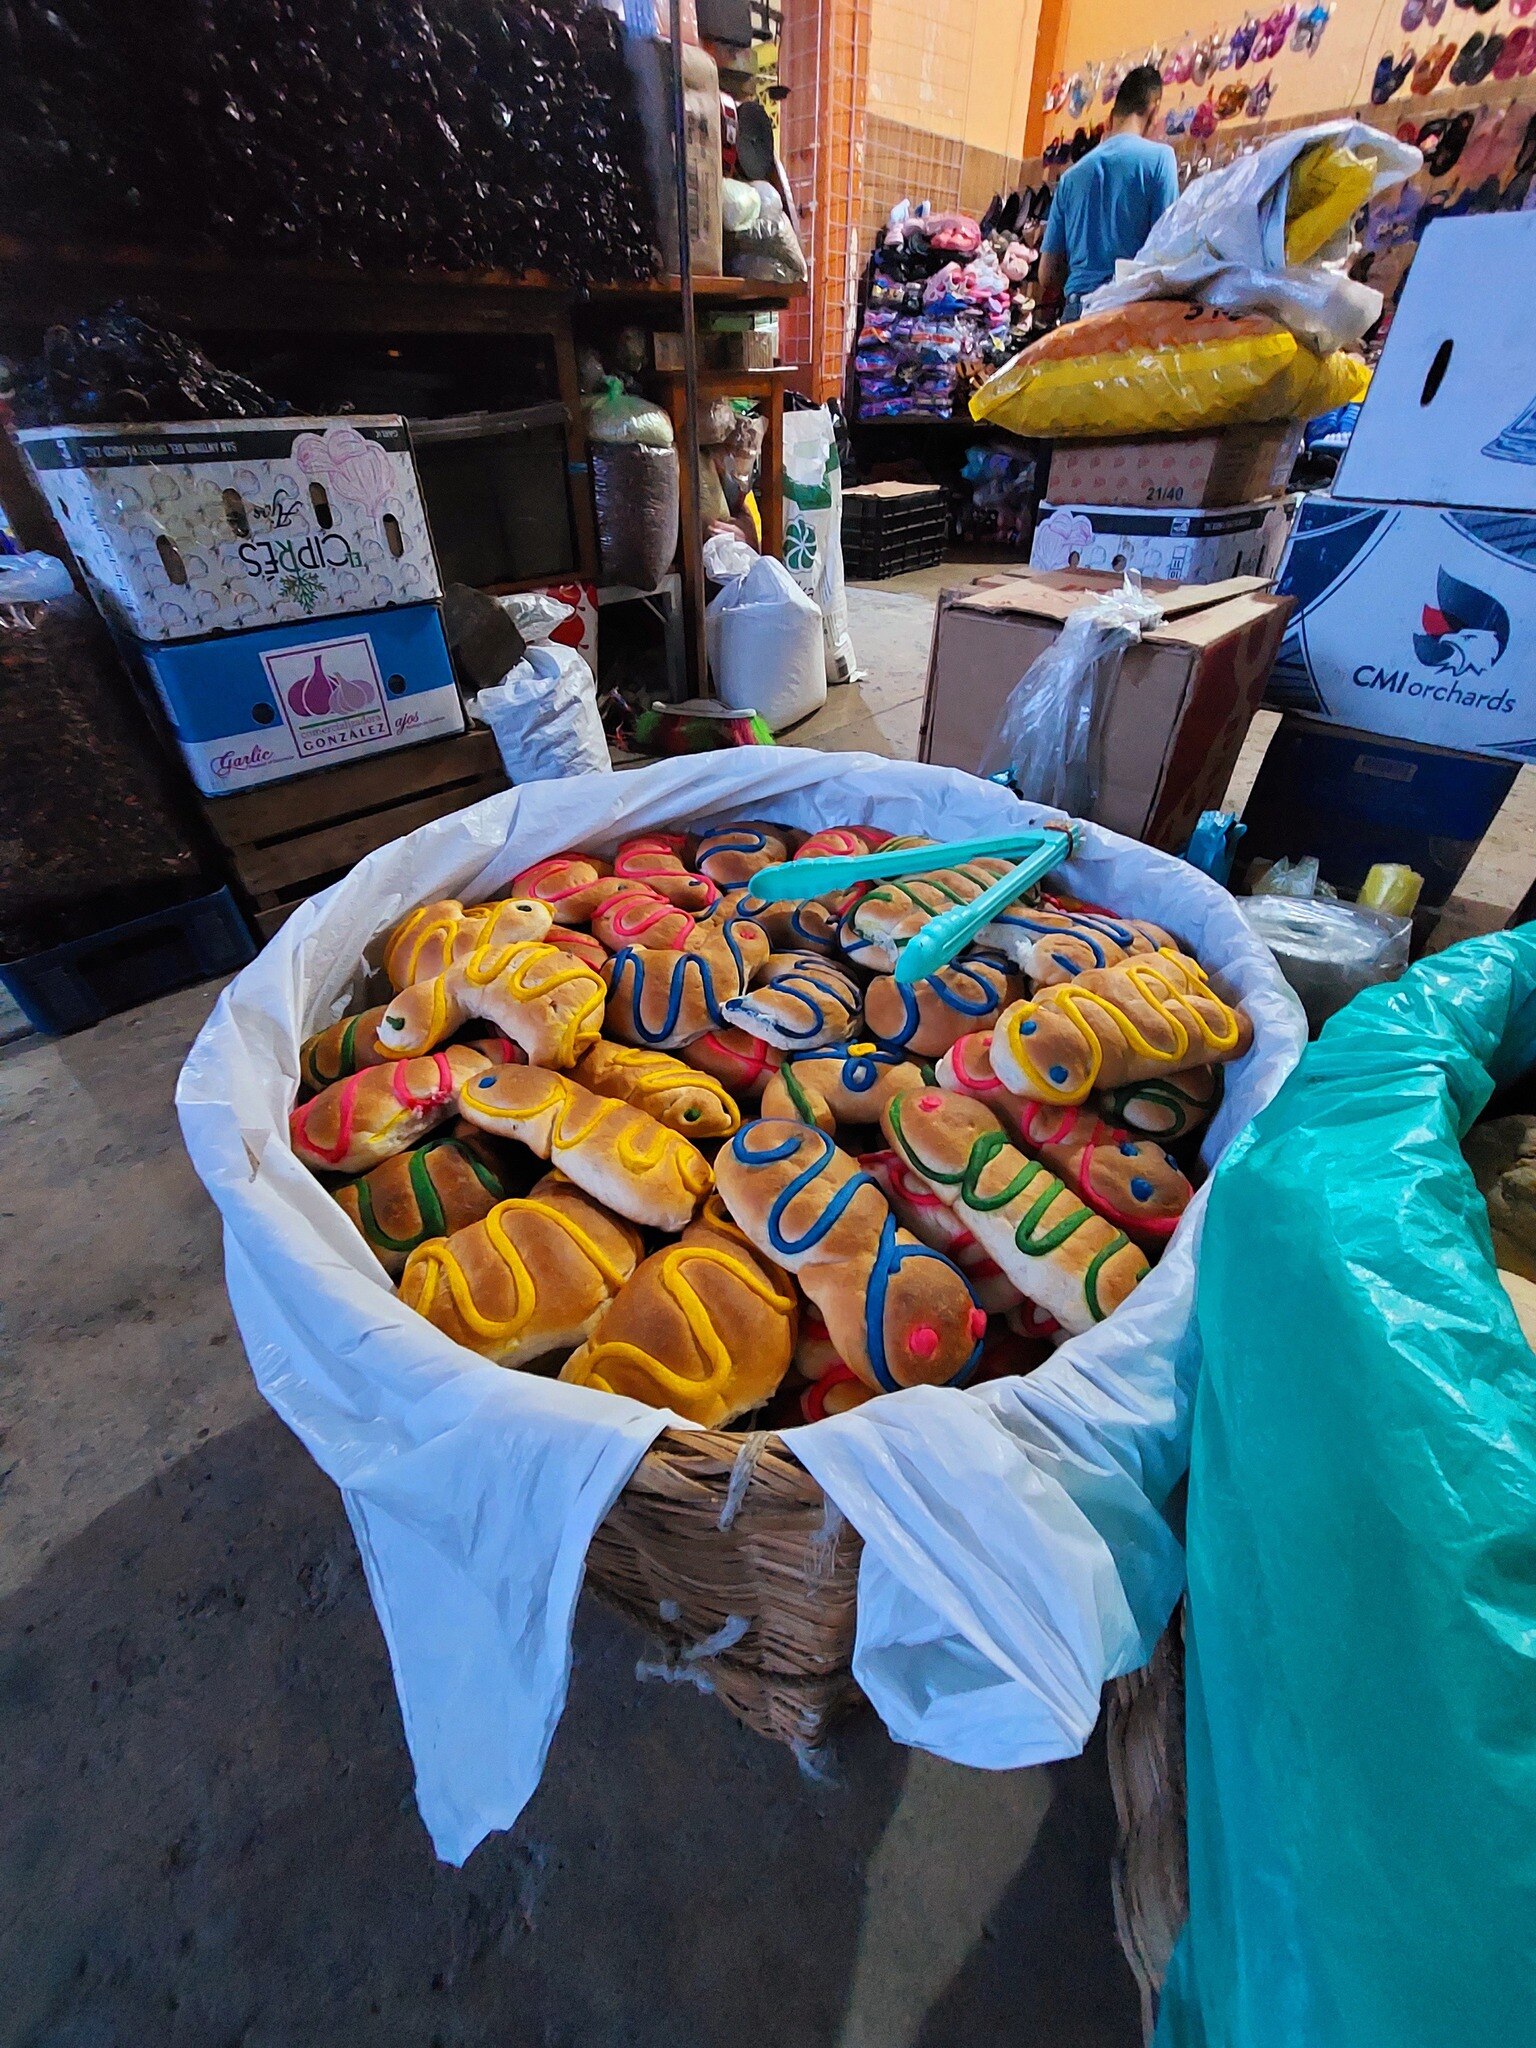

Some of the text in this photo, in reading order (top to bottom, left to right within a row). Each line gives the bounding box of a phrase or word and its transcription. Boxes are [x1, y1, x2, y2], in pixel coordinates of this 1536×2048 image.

[252, 488, 303, 530] Ajos
[1145, 485, 1185, 502] 21/40
[237, 533, 362, 581] EL CIPRÉS
[1352, 664, 1517, 713] CMI orchards
[394, 710, 420, 736] ajos
[210, 744, 275, 778] Garlic
